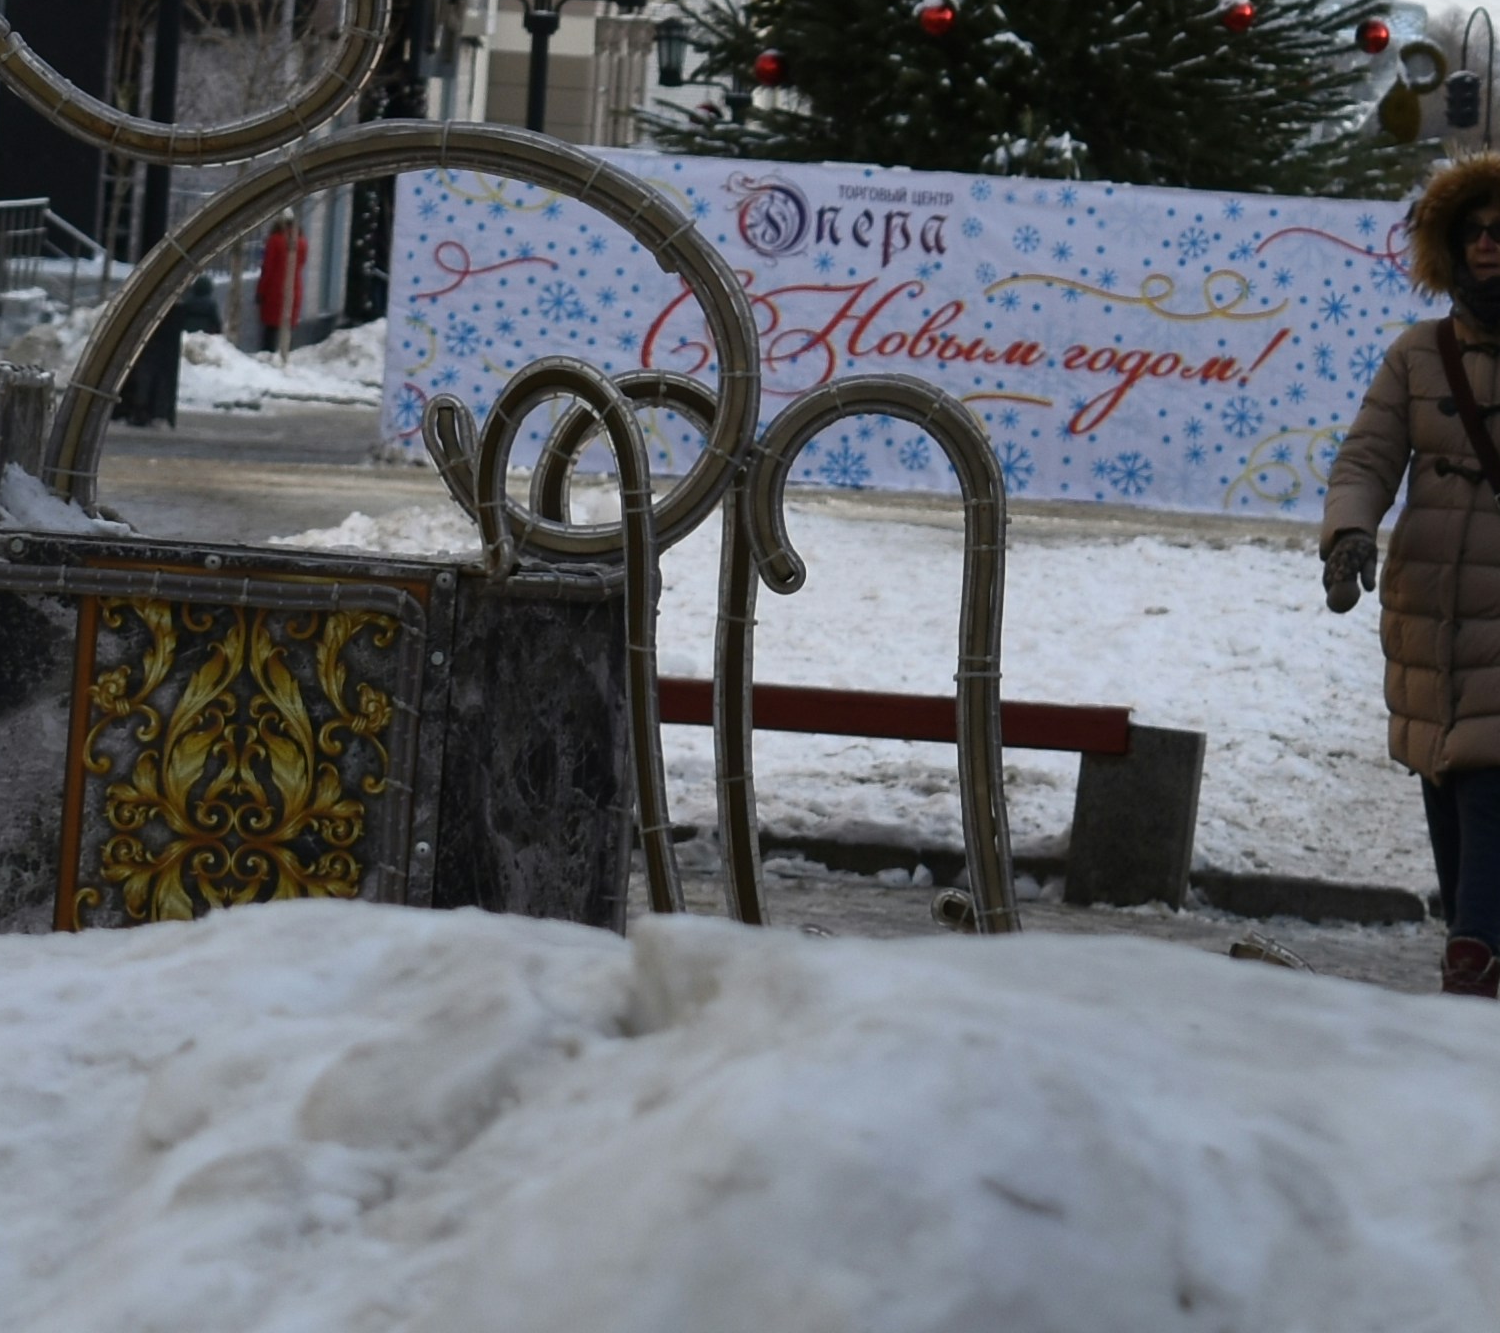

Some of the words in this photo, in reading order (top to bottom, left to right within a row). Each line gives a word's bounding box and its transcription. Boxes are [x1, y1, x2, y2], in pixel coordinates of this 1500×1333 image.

[722, 172, 948, 269] Опера
[837, 183, 908, 204] ТОРГОВЫЙ
[911, 187, 955, 207] ЦЕНТР
[756, 277, 1046, 395] Новым
[1061, 328, 1290, 434] годом!
